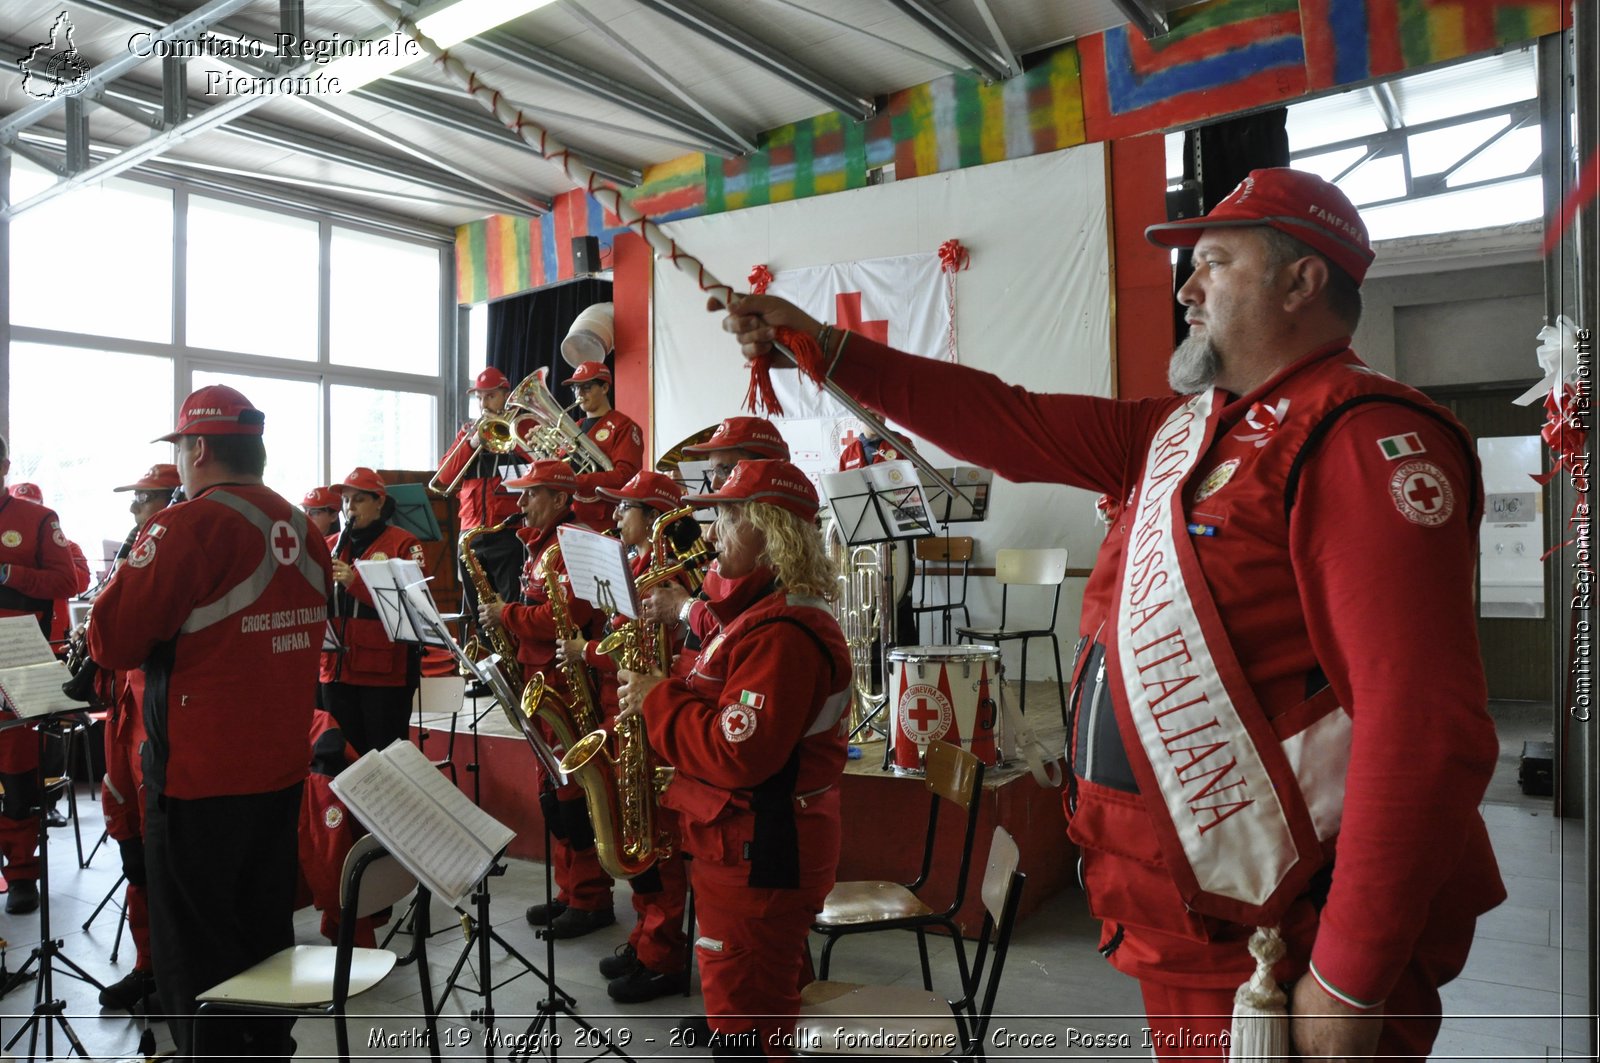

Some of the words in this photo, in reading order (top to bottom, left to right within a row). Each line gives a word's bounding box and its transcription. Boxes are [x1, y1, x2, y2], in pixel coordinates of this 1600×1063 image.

[1308, 204, 1363, 245] FANFARA
[188, 407, 222, 416] FANFARA
[752, 432, 781, 443] FANFARA
[771, 478, 809, 494] FANFARA
[1129, 503, 1175, 637] ROSSA
[241, 613, 271, 633] CROCE
[271, 610, 296, 630] ROSSA
[271, 631, 311, 654] FANFARA
[910, 686, 937, 698] GINEVRA
[936, 694, 945, 704] 22
[940, 702, 951, 731] AGOSTO
[1131, 626, 1257, 837] ITALIANA
